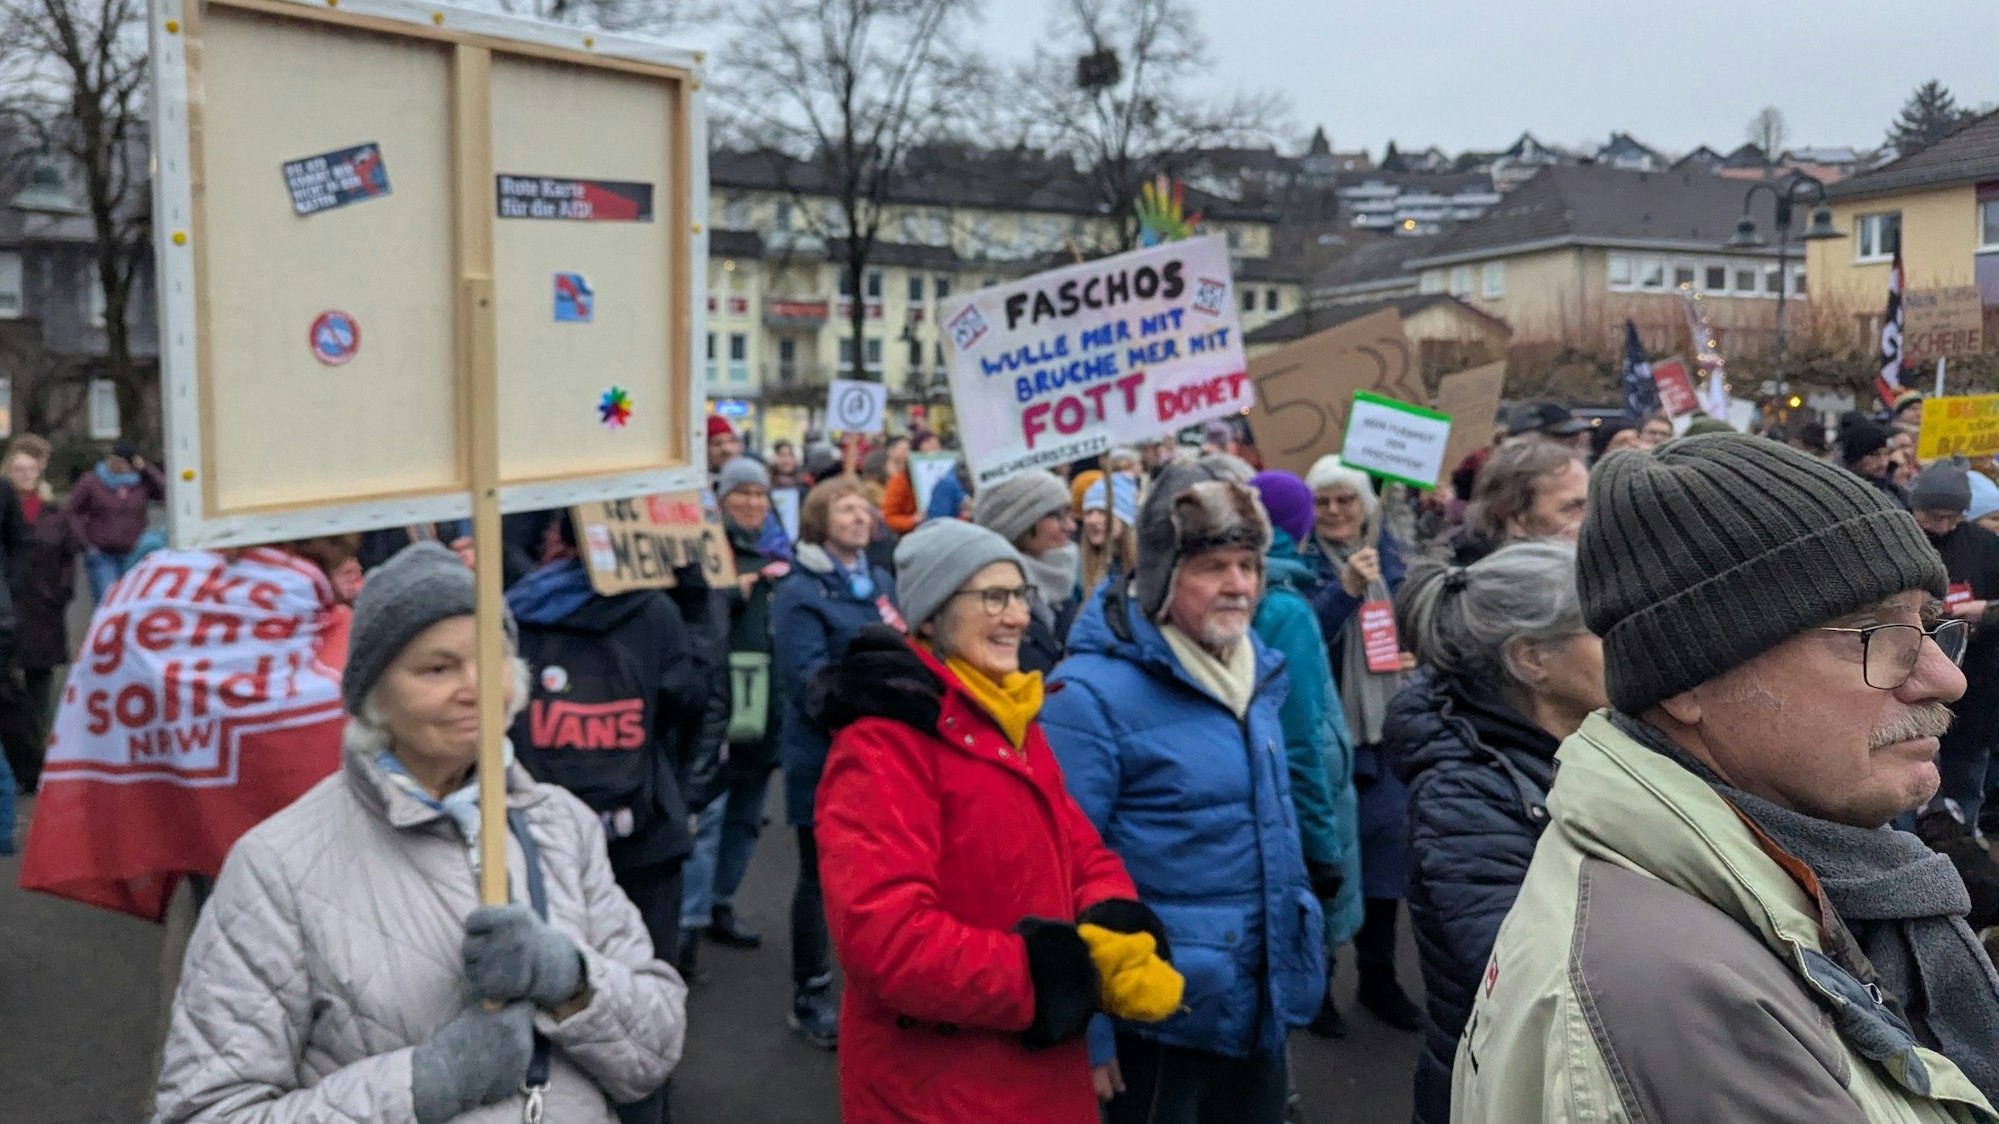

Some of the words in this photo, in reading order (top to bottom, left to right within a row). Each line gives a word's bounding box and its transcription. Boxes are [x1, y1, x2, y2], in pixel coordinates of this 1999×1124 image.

[501, 176, 538, 196] Rote
[540, 177, 586, 199] Karte
[531, 199, 556, 216] die
[1006, 260, 1184, 329] FASCHOS
[980, 335, 1068, 376] WULLE
[1079, 318, 1130, 350] MER
[1021, 371, 1145, 449] FOTT
[129, 722, 214, 762] NRW
[530, 699, 646, 749] VANS
